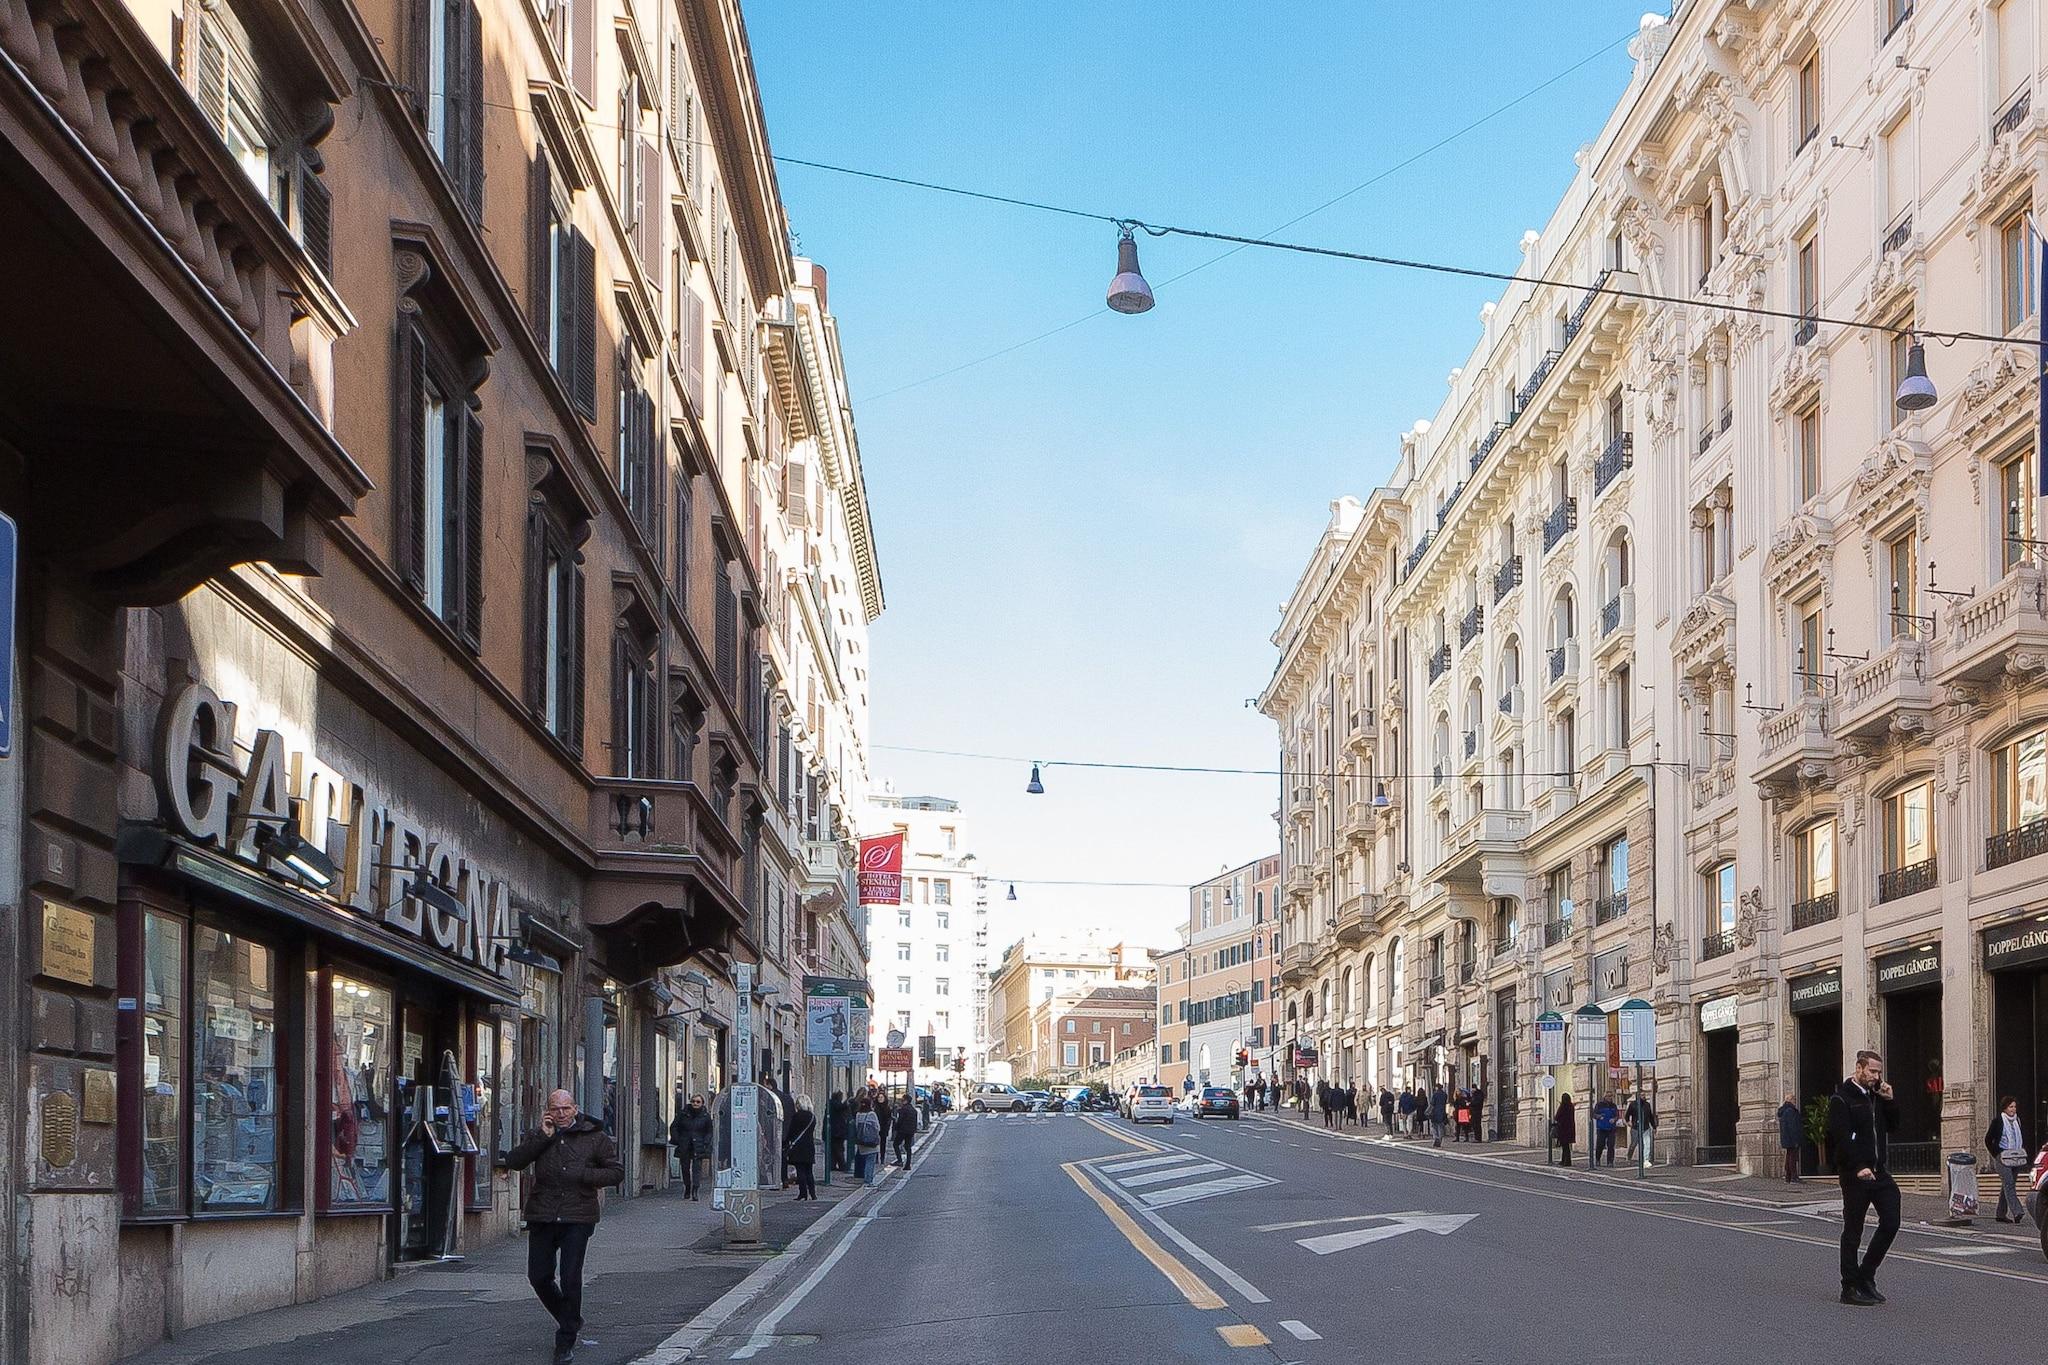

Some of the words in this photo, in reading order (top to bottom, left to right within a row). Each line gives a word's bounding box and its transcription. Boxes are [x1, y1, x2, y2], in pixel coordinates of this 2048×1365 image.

[155, 684, 512, 980] GATTEGNA
[861, 878, 899, 887] STENDHAL
[1880, 957, 1938, 981] DOPPELGÄNGER
[1793, 980, 1840, 1001] DOPPELGÄNGER
